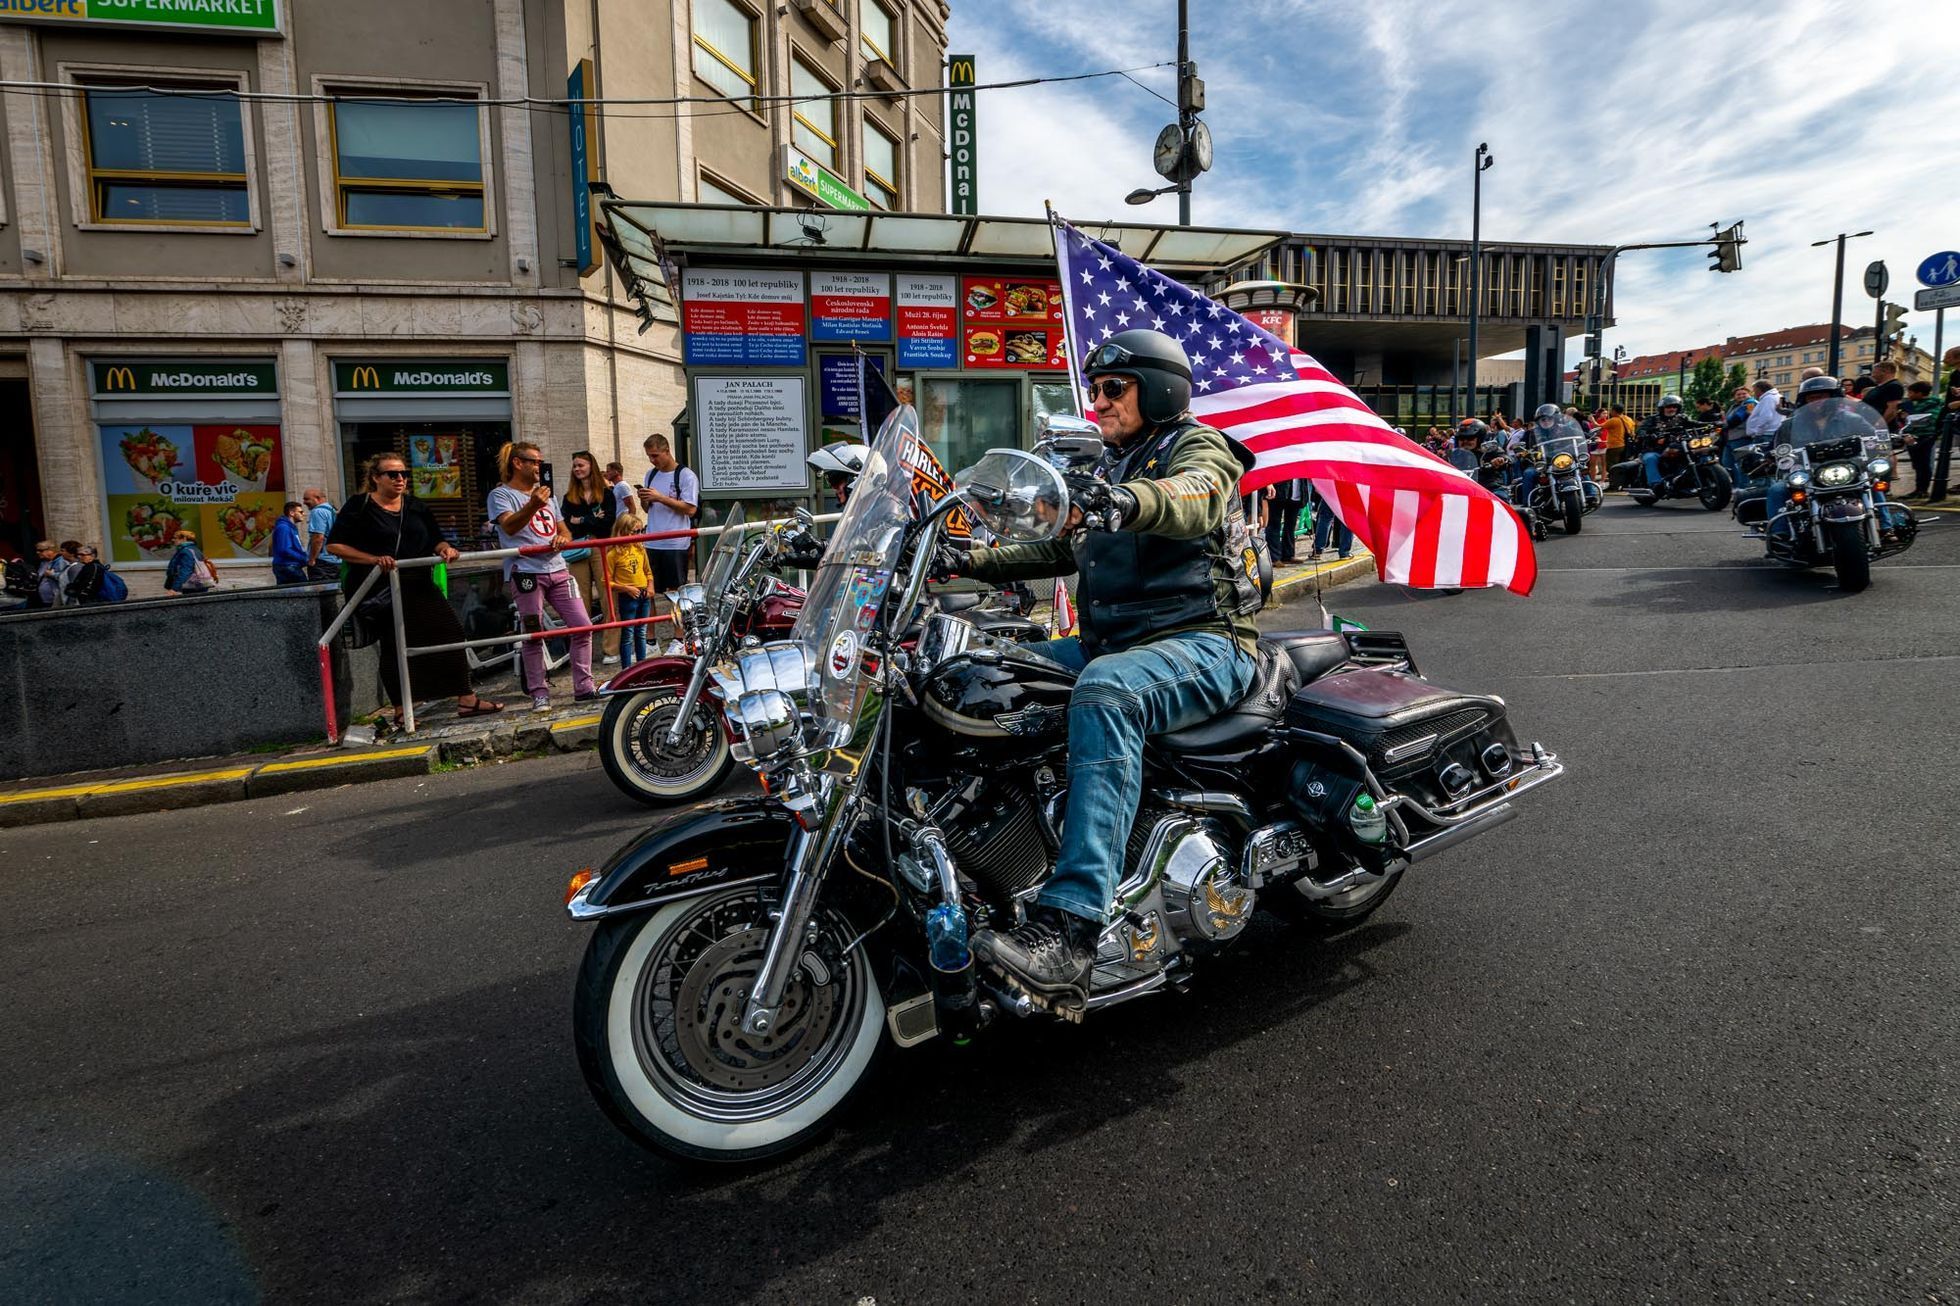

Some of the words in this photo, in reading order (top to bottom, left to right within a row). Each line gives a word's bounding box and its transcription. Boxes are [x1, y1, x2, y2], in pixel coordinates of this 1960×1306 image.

[573, 90, 586, 250] HOTEL
[820, 180, 867, 210] SUPERMARK
[712, 278, 730, 286] 2018
[760, 280, 799, 290] republiky
[846, 286, 880, 295] republiky
[151, 373, 258, 387] McDonald's
[394, 372, 493, 385] McDonald's
[160, 483, 172, 494] O
[177, 482, 211, 496] kuře
